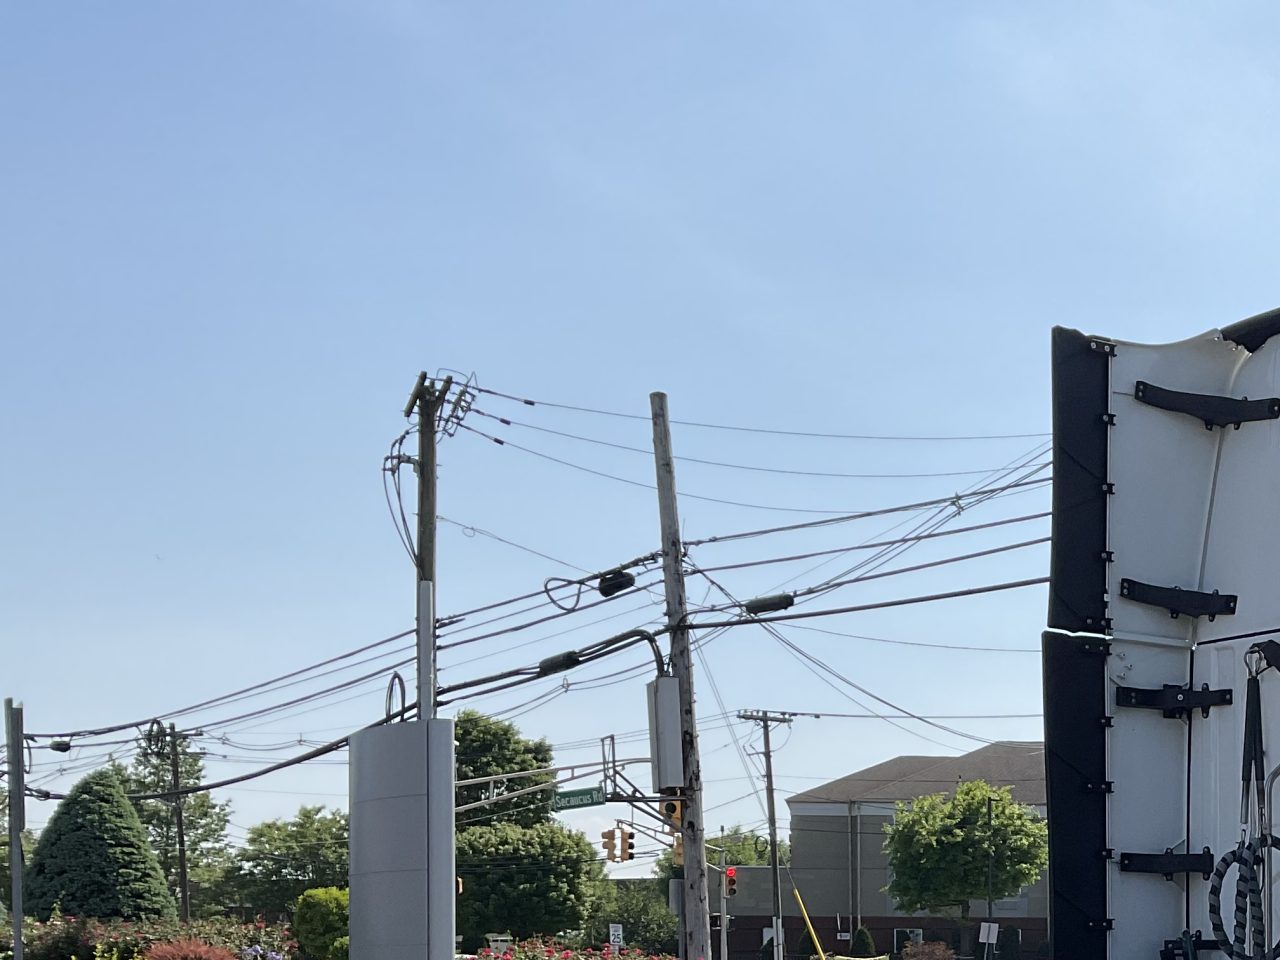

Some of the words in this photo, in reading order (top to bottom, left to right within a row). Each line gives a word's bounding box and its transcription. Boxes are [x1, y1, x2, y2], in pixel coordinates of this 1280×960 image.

[555, 794, 592, 808] Secaucus
[592, 790, 603, 803] Rd
[611, 933, 622, 944] 25
